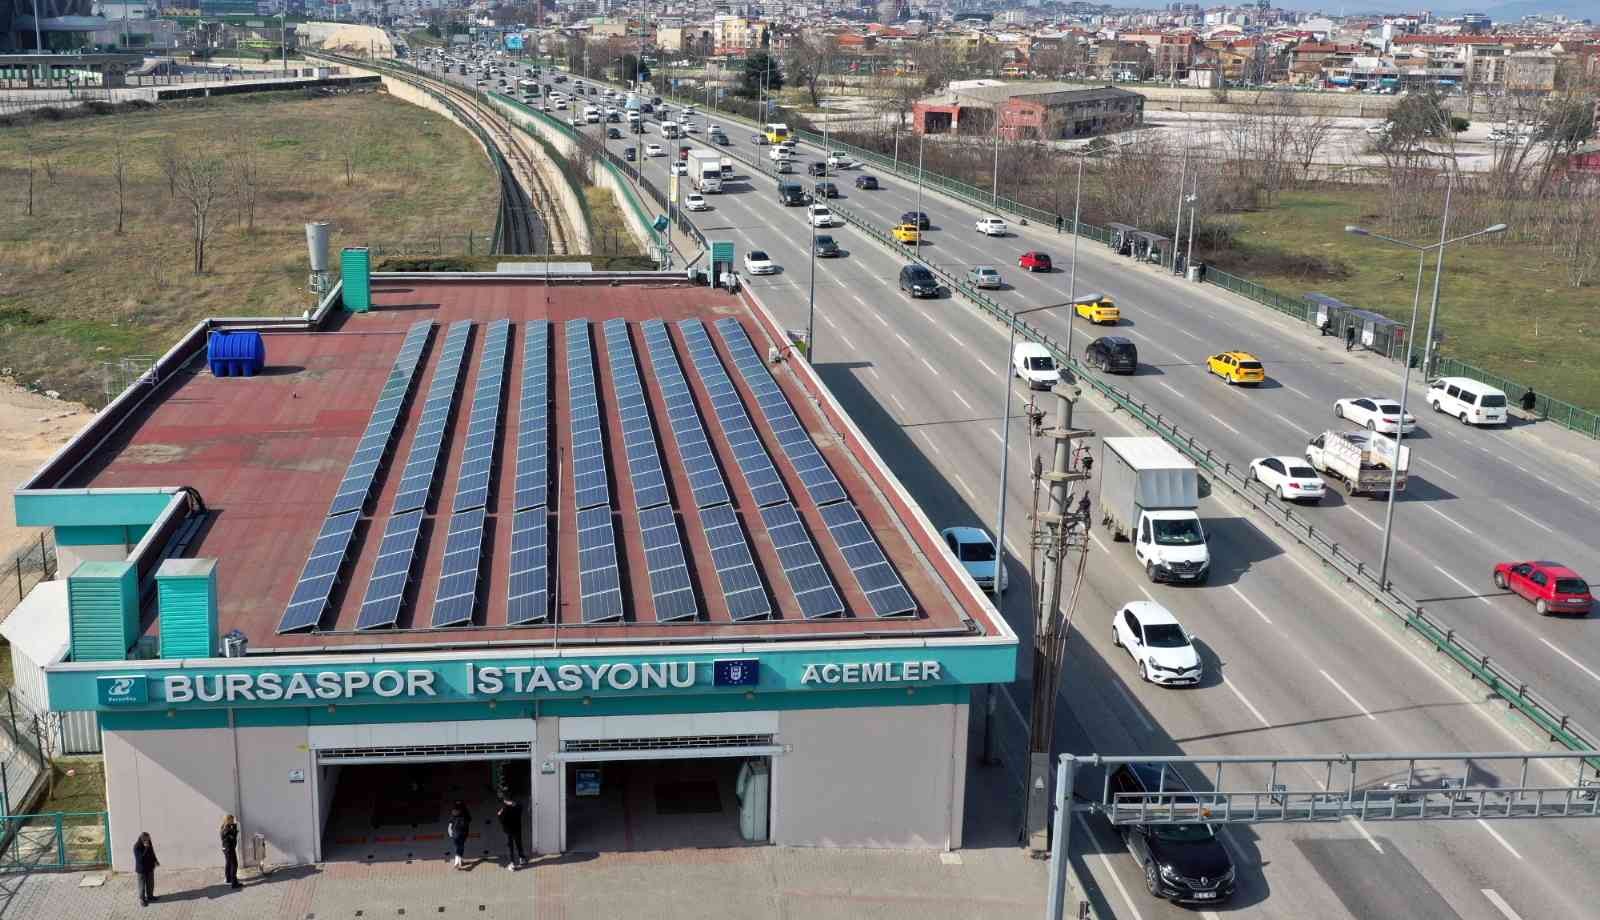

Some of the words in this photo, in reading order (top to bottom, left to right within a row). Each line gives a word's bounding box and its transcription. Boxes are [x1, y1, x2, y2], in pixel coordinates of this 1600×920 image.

[164, 669, 437, 703] BURSASPOR
[466, 662, 696, 695] İSTASYONU
[800, 660, 941, 684] ACEMLER
